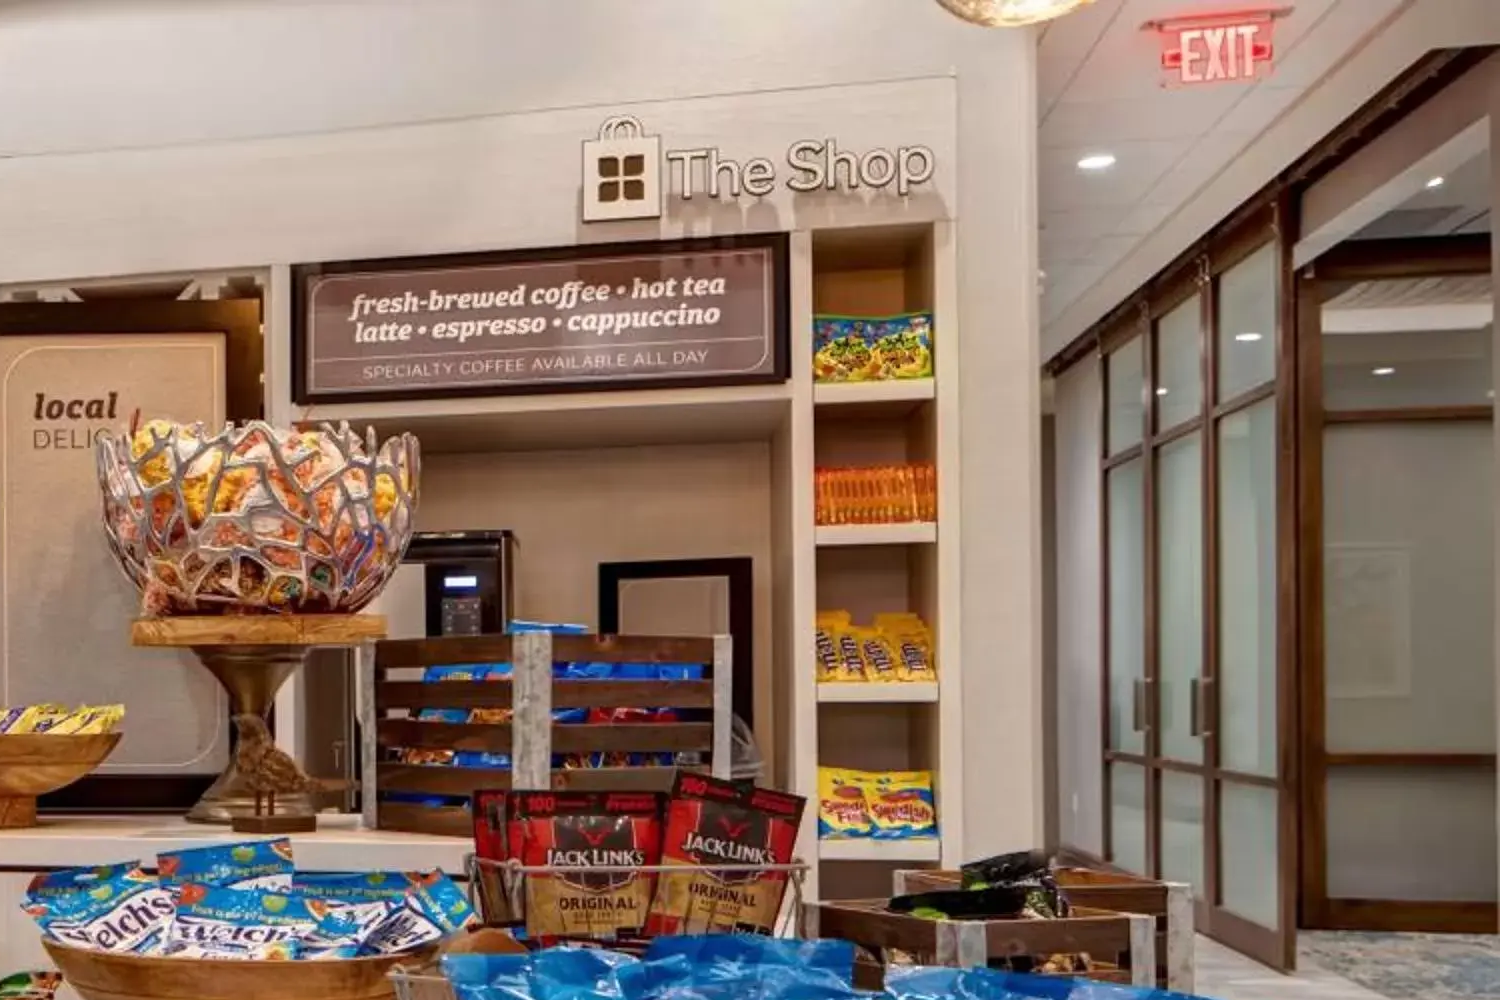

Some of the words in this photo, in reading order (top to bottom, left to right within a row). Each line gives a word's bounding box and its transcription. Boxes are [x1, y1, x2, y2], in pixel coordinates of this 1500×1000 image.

[1179, 25, 1261, 83] EXIT
[666, 147, 775, 200] The
[785, 138, 935, 196] Shop
[349, 285, 525, 321] fresh-brewed
[530, 282, 610, 309] coffee
[631, 277, 679, 300] hot
[683, 276, 726, 297] tea
[355, 321, 413, 343] latte
[431, 313, 547, 342] espresso
[567, 302, 721, 335] cappuccino
[363, 361, 454, 380] SPECIALTY
[459, 357, 526, 376] COFFEE
[531, 351, 627, 372] AVAILABLE
[632, 351, 667, 367] ALL
[673, 349, 709, 365] DAY
[33, 391, 119, 421] local
[547, 850, 590, 867] JACK
[682, 831, 726, 857] JACK
[559, 896, 637, 911] ORIGINAL
